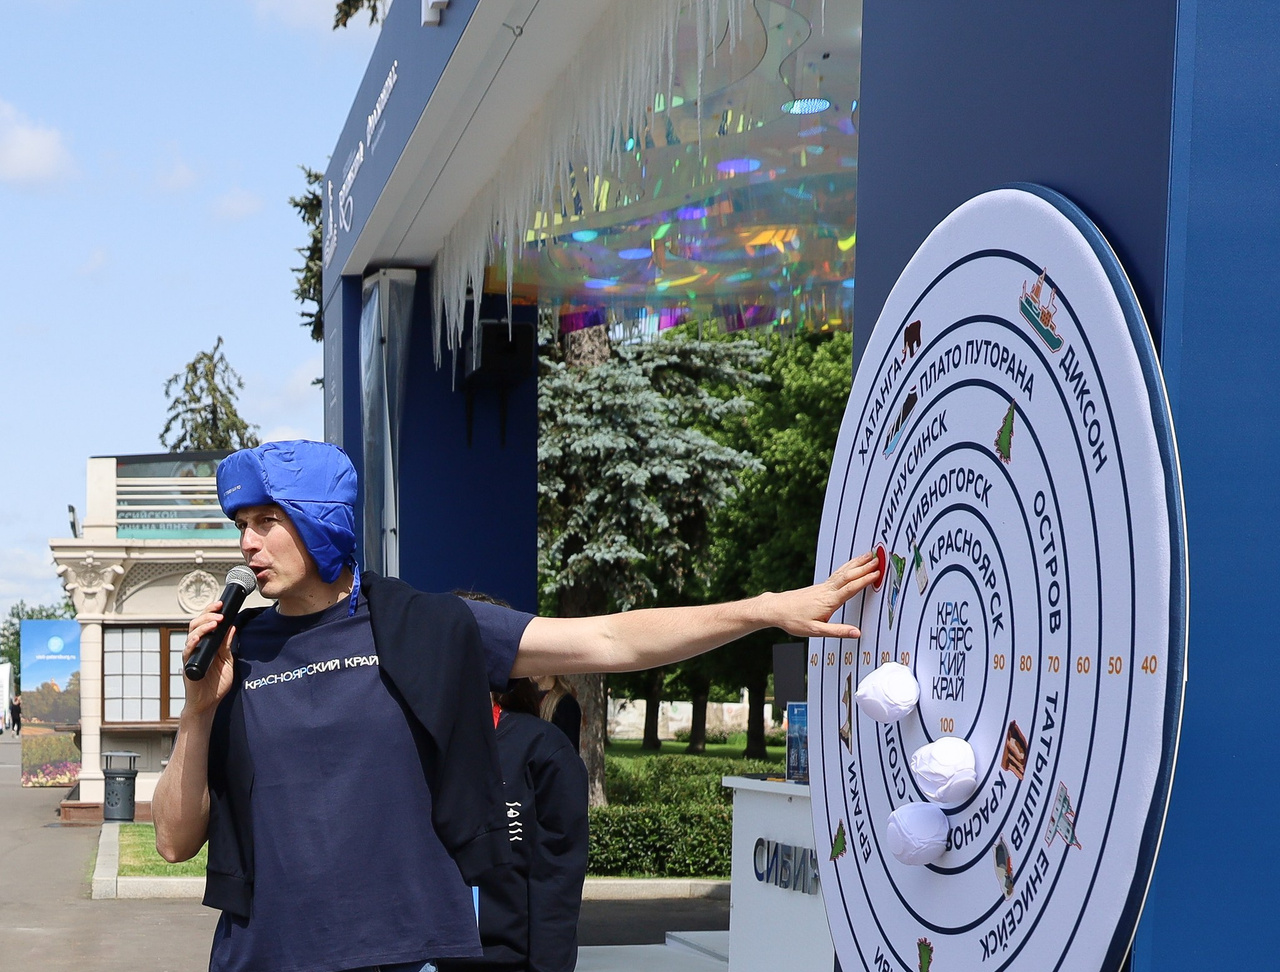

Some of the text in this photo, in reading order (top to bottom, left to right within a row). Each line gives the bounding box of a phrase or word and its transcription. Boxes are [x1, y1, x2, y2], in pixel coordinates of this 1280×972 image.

[858, 357, 902, 466] ХАТАНГА
[920, 339, 1035, 402] ПЛАТО ПУТОРАНА
[1058, 344, 1108, 474] ДИКСОН
[881, 409, 948, 544] МИНУСИНСК
[905, 467, 993, 553] ДИВНОГОРСК
[928, 528, 1004, 639] КРАСНОЯРСК
[1033, 490, 1061, 634] ОСТРОВ
[929, 627, 973, 651] НОЯРС
[936, 601, 969, 626] КРАС
[245, 655, 379, 690] КРАСНОЯРСКИЙ КРАЙ
[809, 651, 1158, 675] 40 50 60 70 80 90 90 80 70 60 50 40
[932, 676, 965, 702] КРАЙ
[939, 651, 966, 677] КИЙ
[940, 717, 955, 733] 100
[1010, 691, 1059, 852] ТАТЫШЕВ
[837, 760, 872, 864] ЕРГАКИ
[884, 722, 1007, 852] КРАСНОЯ СТОЛ
[979, 848, 1050, 962] ЕНИСЕЙСК
